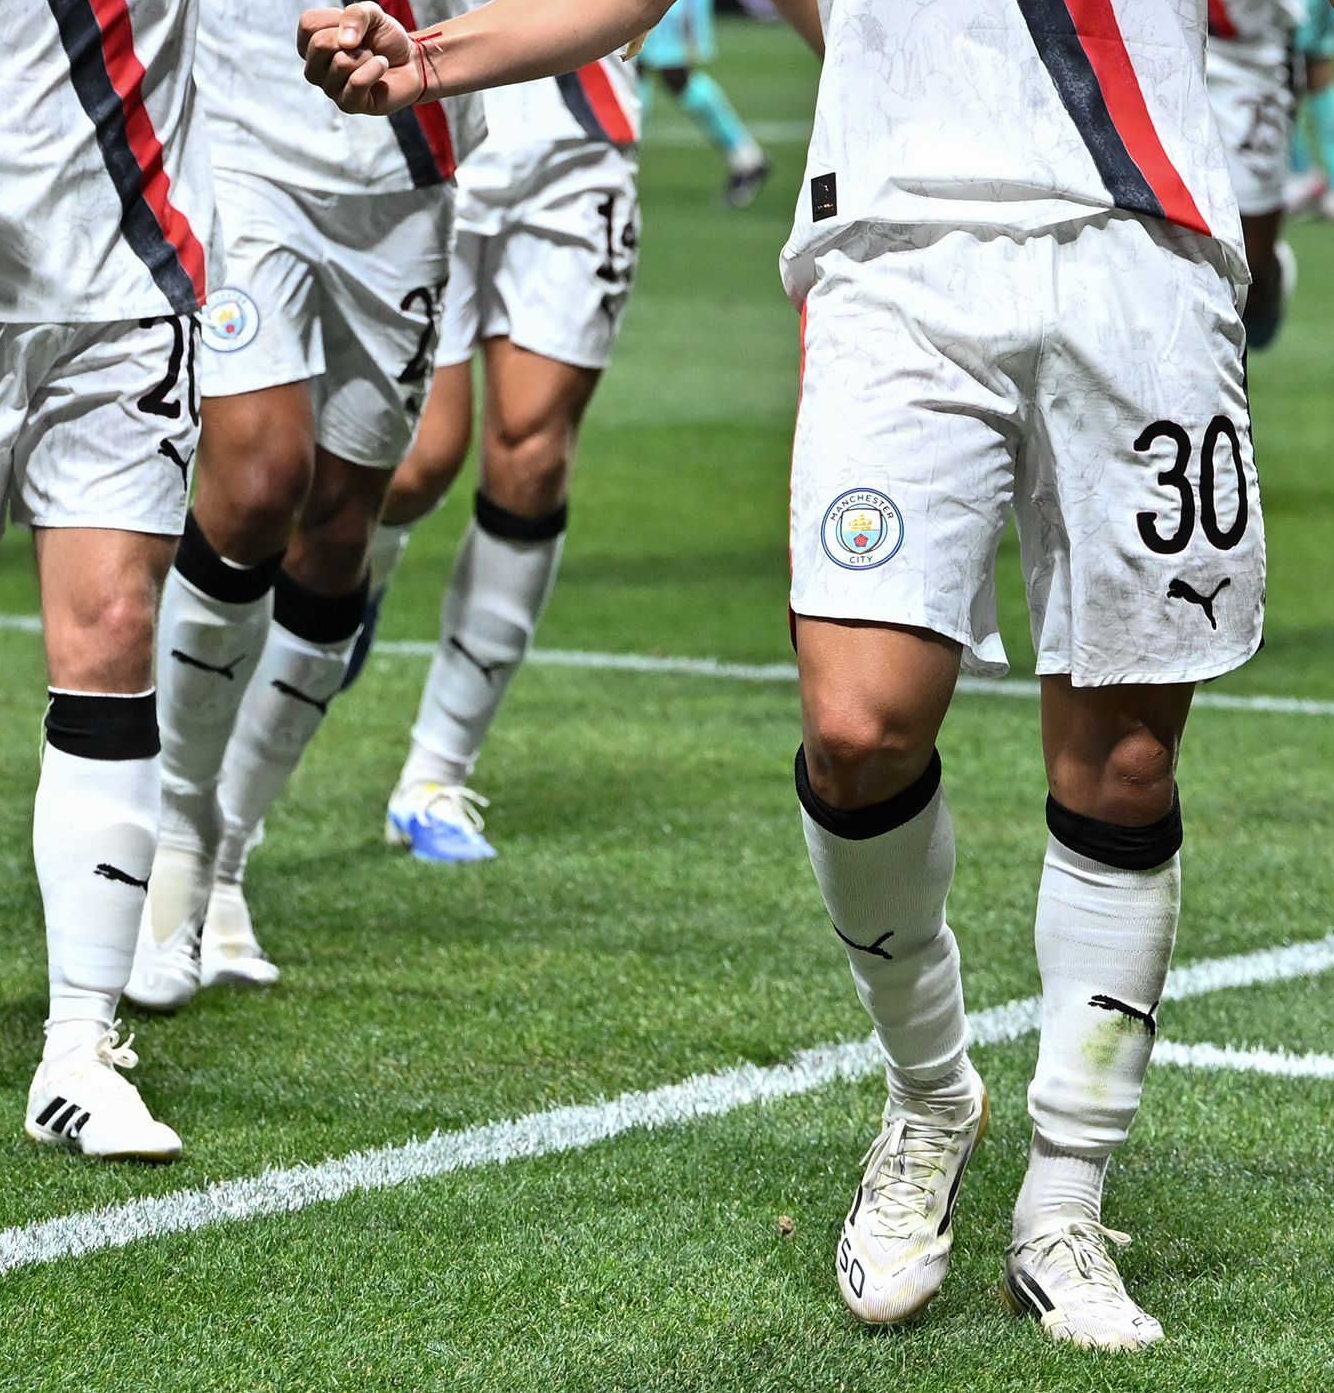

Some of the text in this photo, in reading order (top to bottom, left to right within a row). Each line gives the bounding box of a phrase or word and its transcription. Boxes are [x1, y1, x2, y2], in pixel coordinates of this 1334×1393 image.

[398, 278, 449, 384] 2
[830, 494, 895, 521] MANCHESTER
[1133, 414, 1248, 555] 30
[849, 555, 874, 564] CITY
